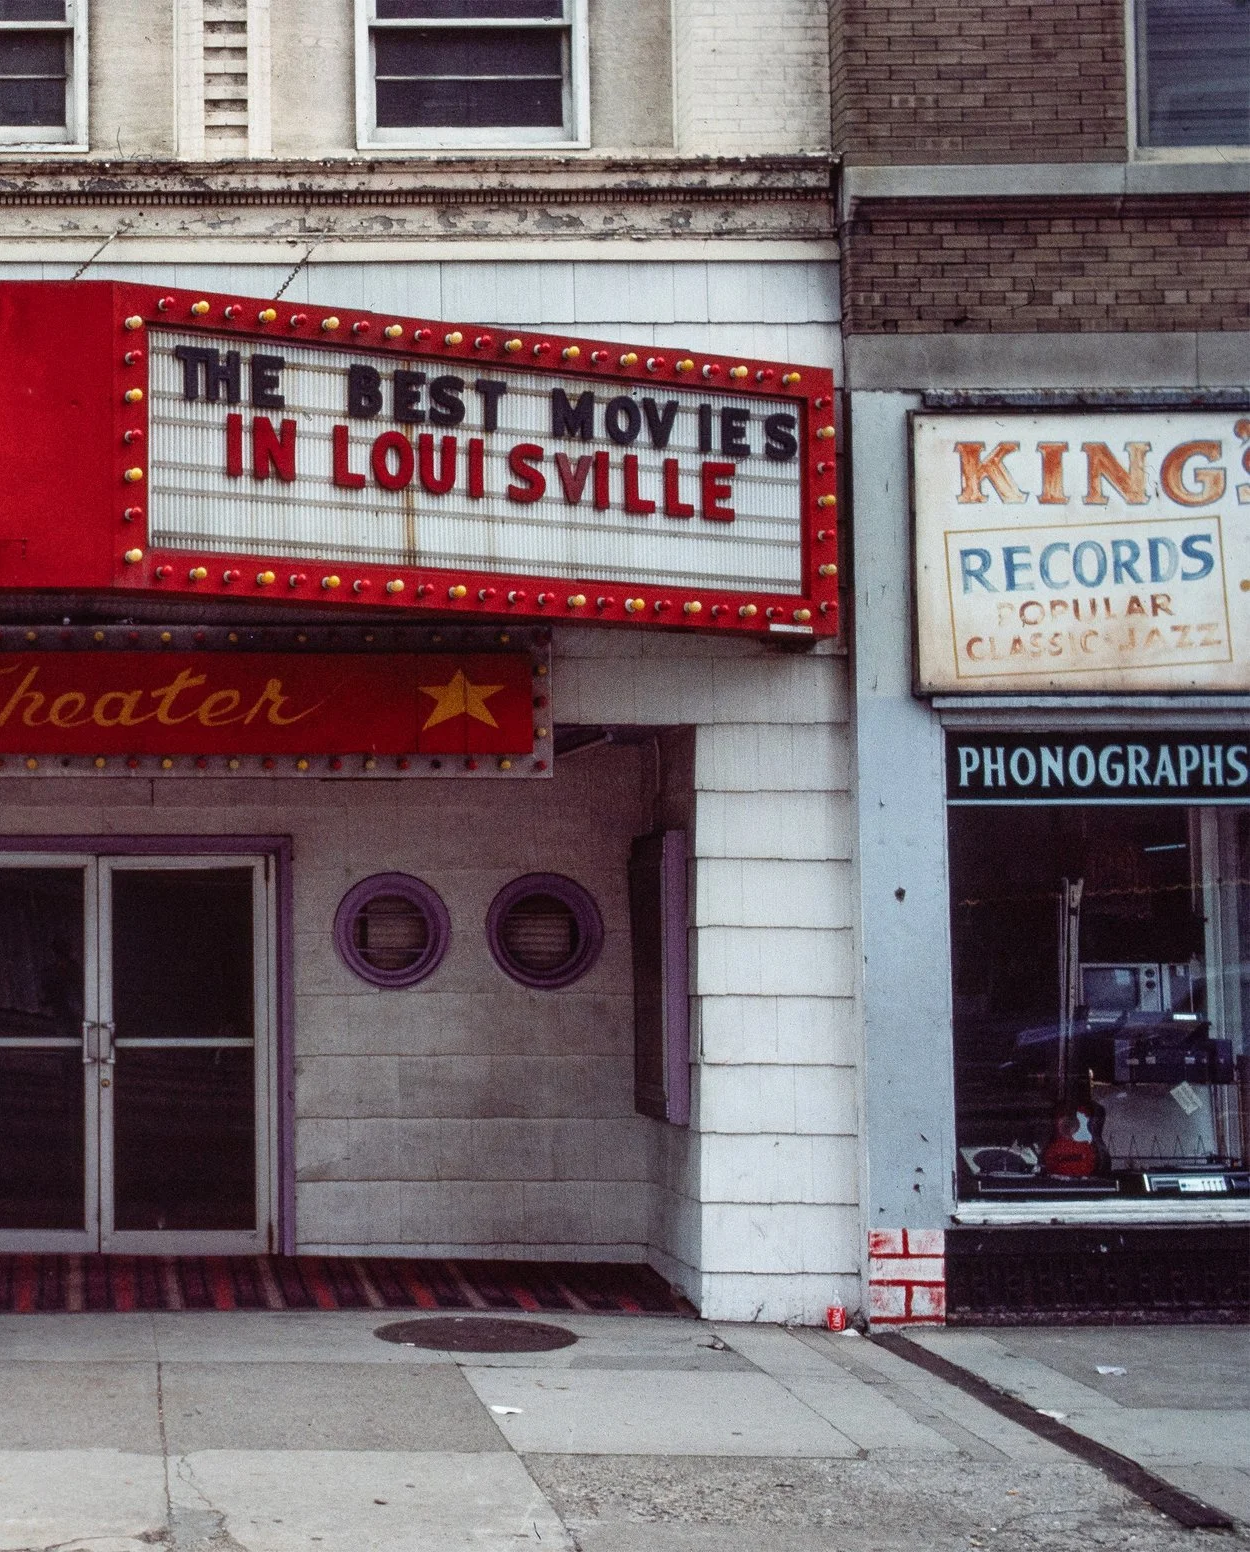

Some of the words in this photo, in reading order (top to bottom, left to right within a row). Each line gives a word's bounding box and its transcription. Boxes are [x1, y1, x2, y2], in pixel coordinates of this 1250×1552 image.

[175, 344, 286, 409] THE
[348, 363, 508, 433] BEST
[550, 387, 799, 461] MOVIES
[225, 412, 297, 482] IN
[332, 425, 737, 522] LOUISVILLE
[953, 416, 1250, 507] KING'
[959, 533, 1215, 595] RECORDS
[996, 592, 1176, 628] POPULAR
[1118, 622, 1223, 653] JAZZ
[957, 743, 1249, 788] PHONOGRAPHS
